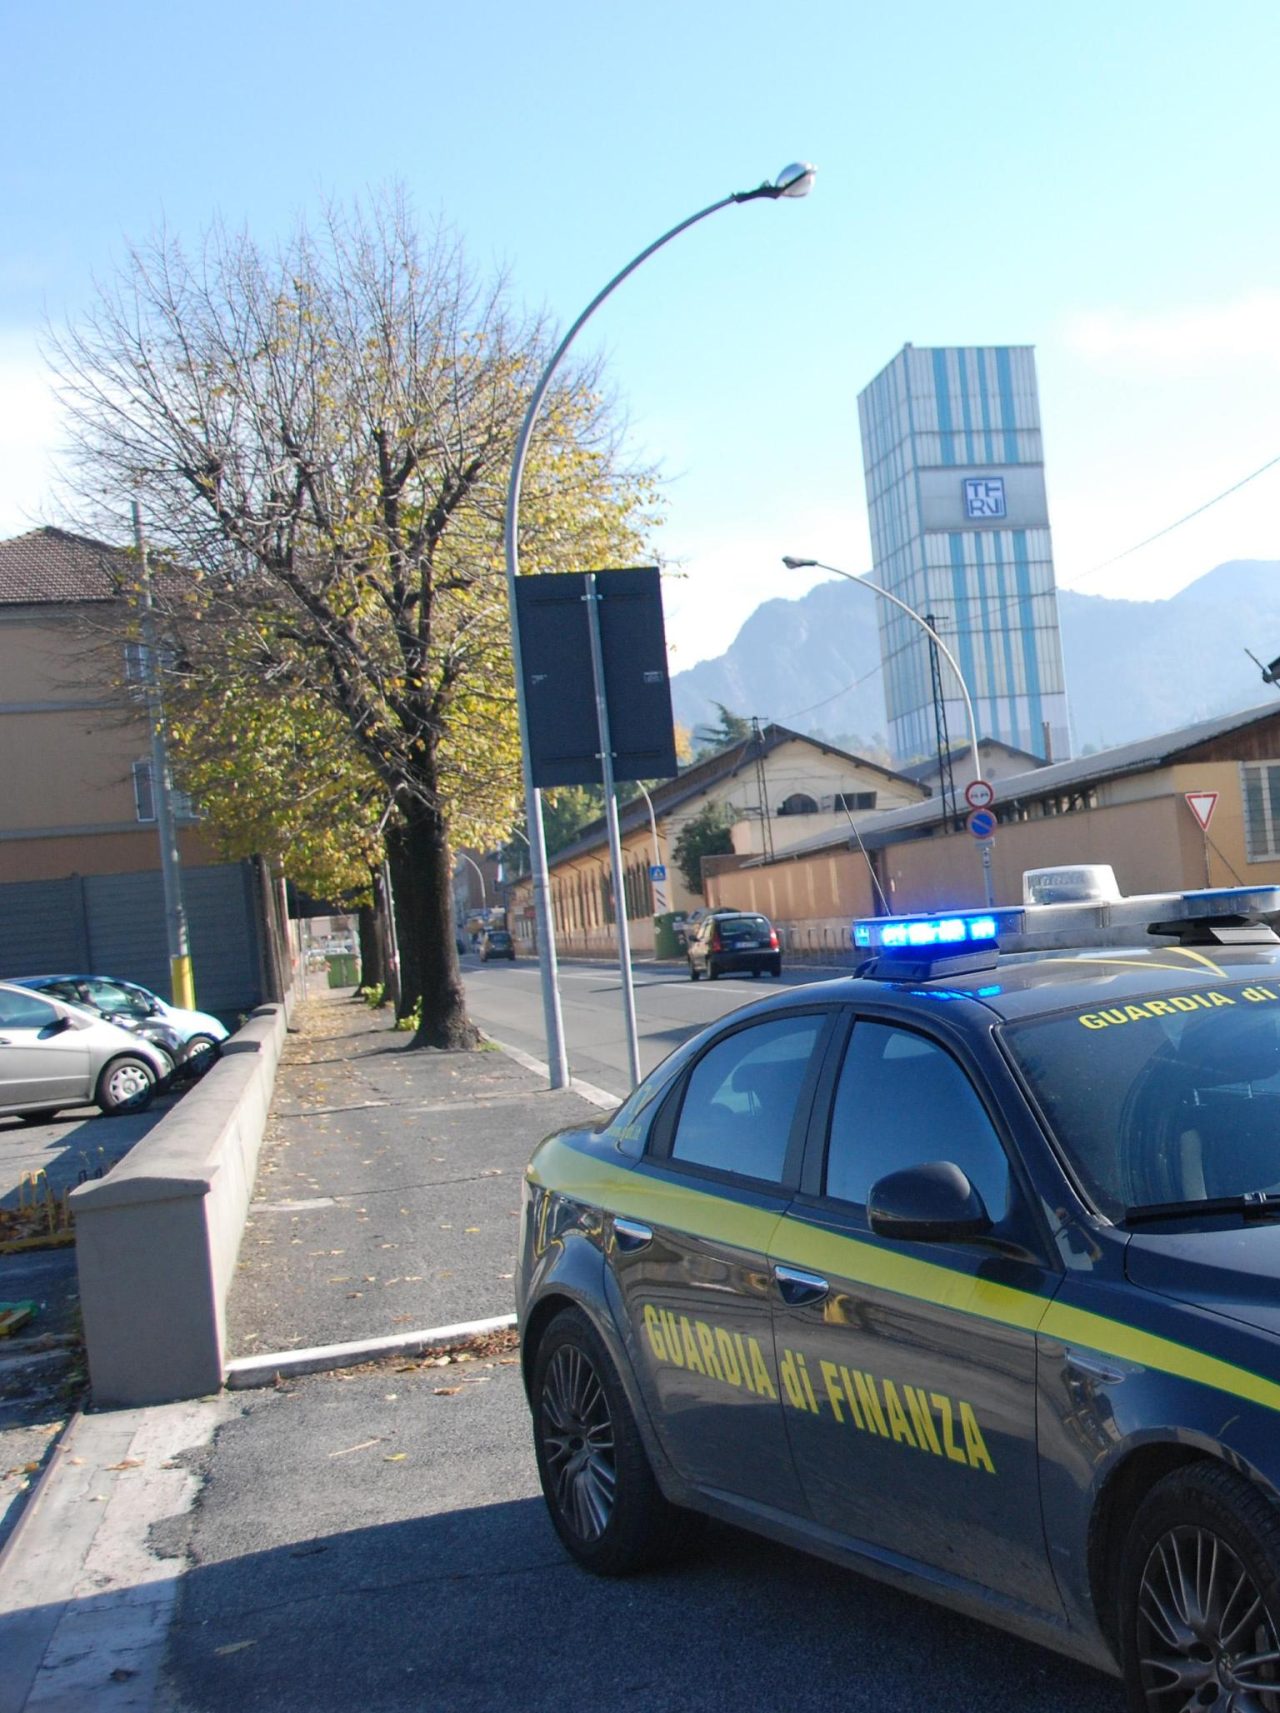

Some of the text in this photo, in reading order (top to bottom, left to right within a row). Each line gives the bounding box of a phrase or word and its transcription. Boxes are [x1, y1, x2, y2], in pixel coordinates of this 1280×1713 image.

[1078, 991, 1234, 1031] GUARDIA
[1241, 985, 1278, 1003] di
[643, 1304, 998, 1475] GUARDIA di FINANZA
